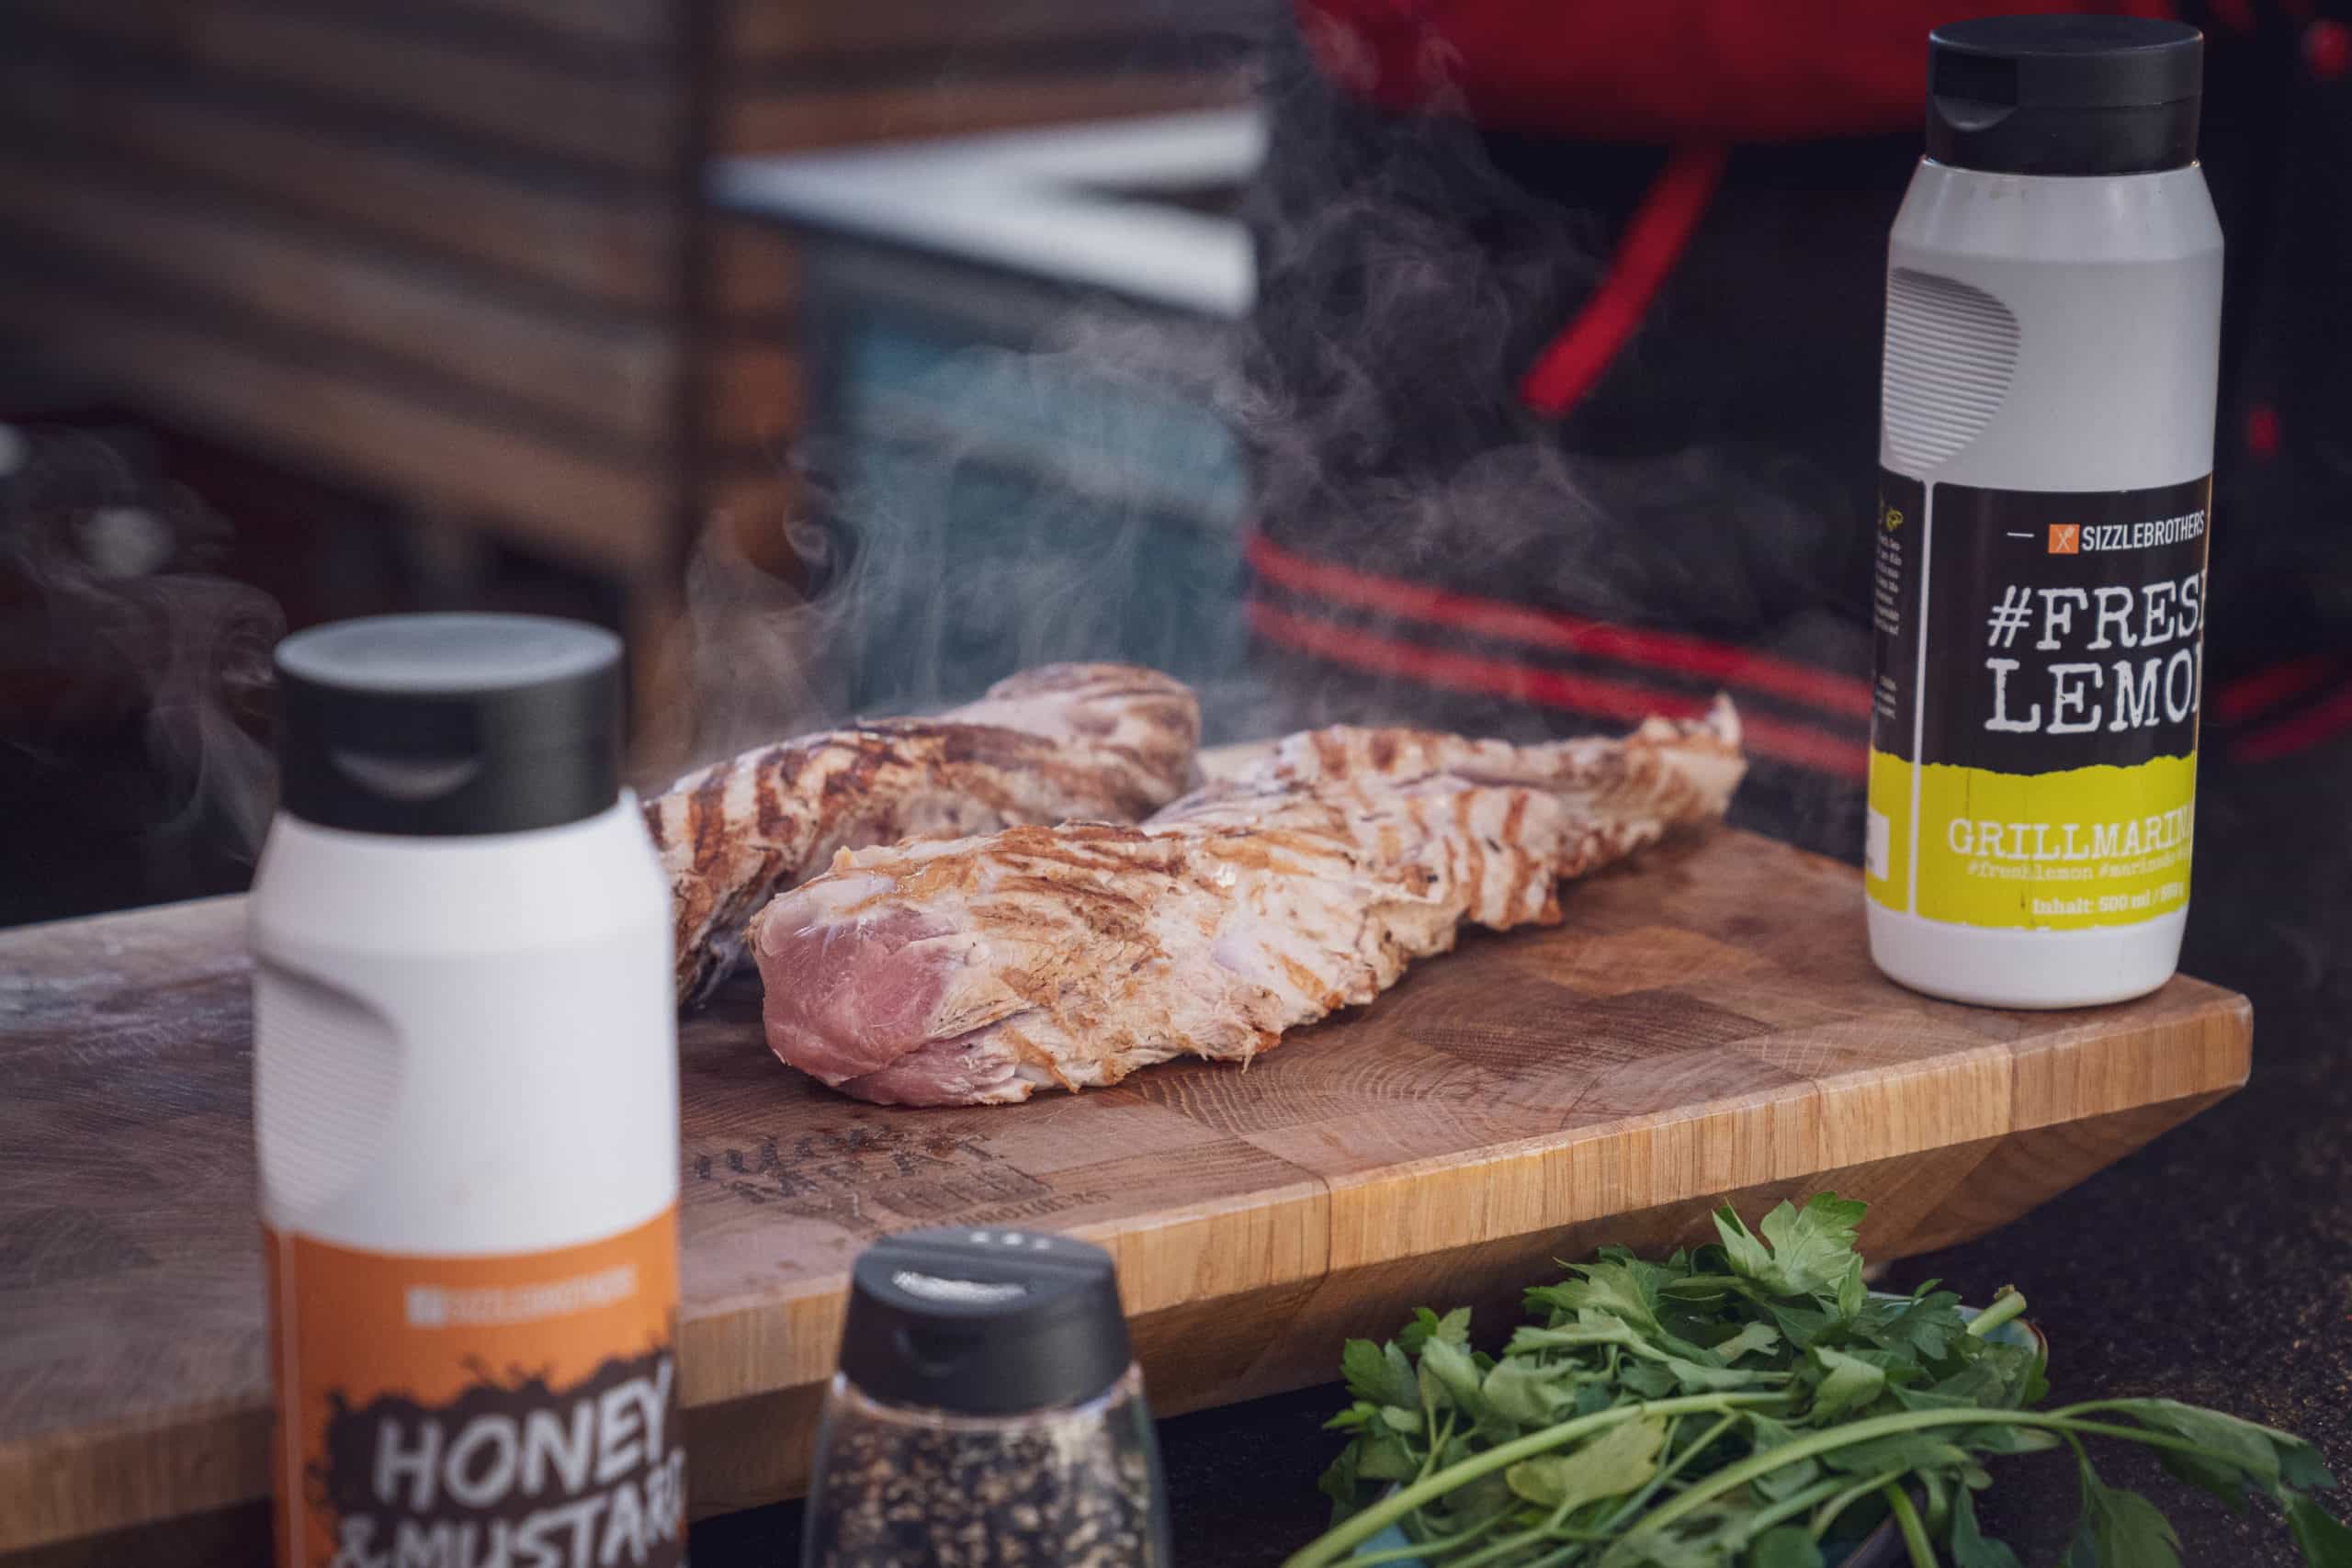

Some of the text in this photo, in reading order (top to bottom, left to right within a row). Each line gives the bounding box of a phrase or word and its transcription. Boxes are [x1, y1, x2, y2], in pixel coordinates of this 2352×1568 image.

[2081, 509, 2205, 551] SIZZLEBROTHERS
[1985, 569, 2206, 651] #FRES
[2098, 892, 2130, 912] 500
[372, 1356, 673, 1511] HONEY
